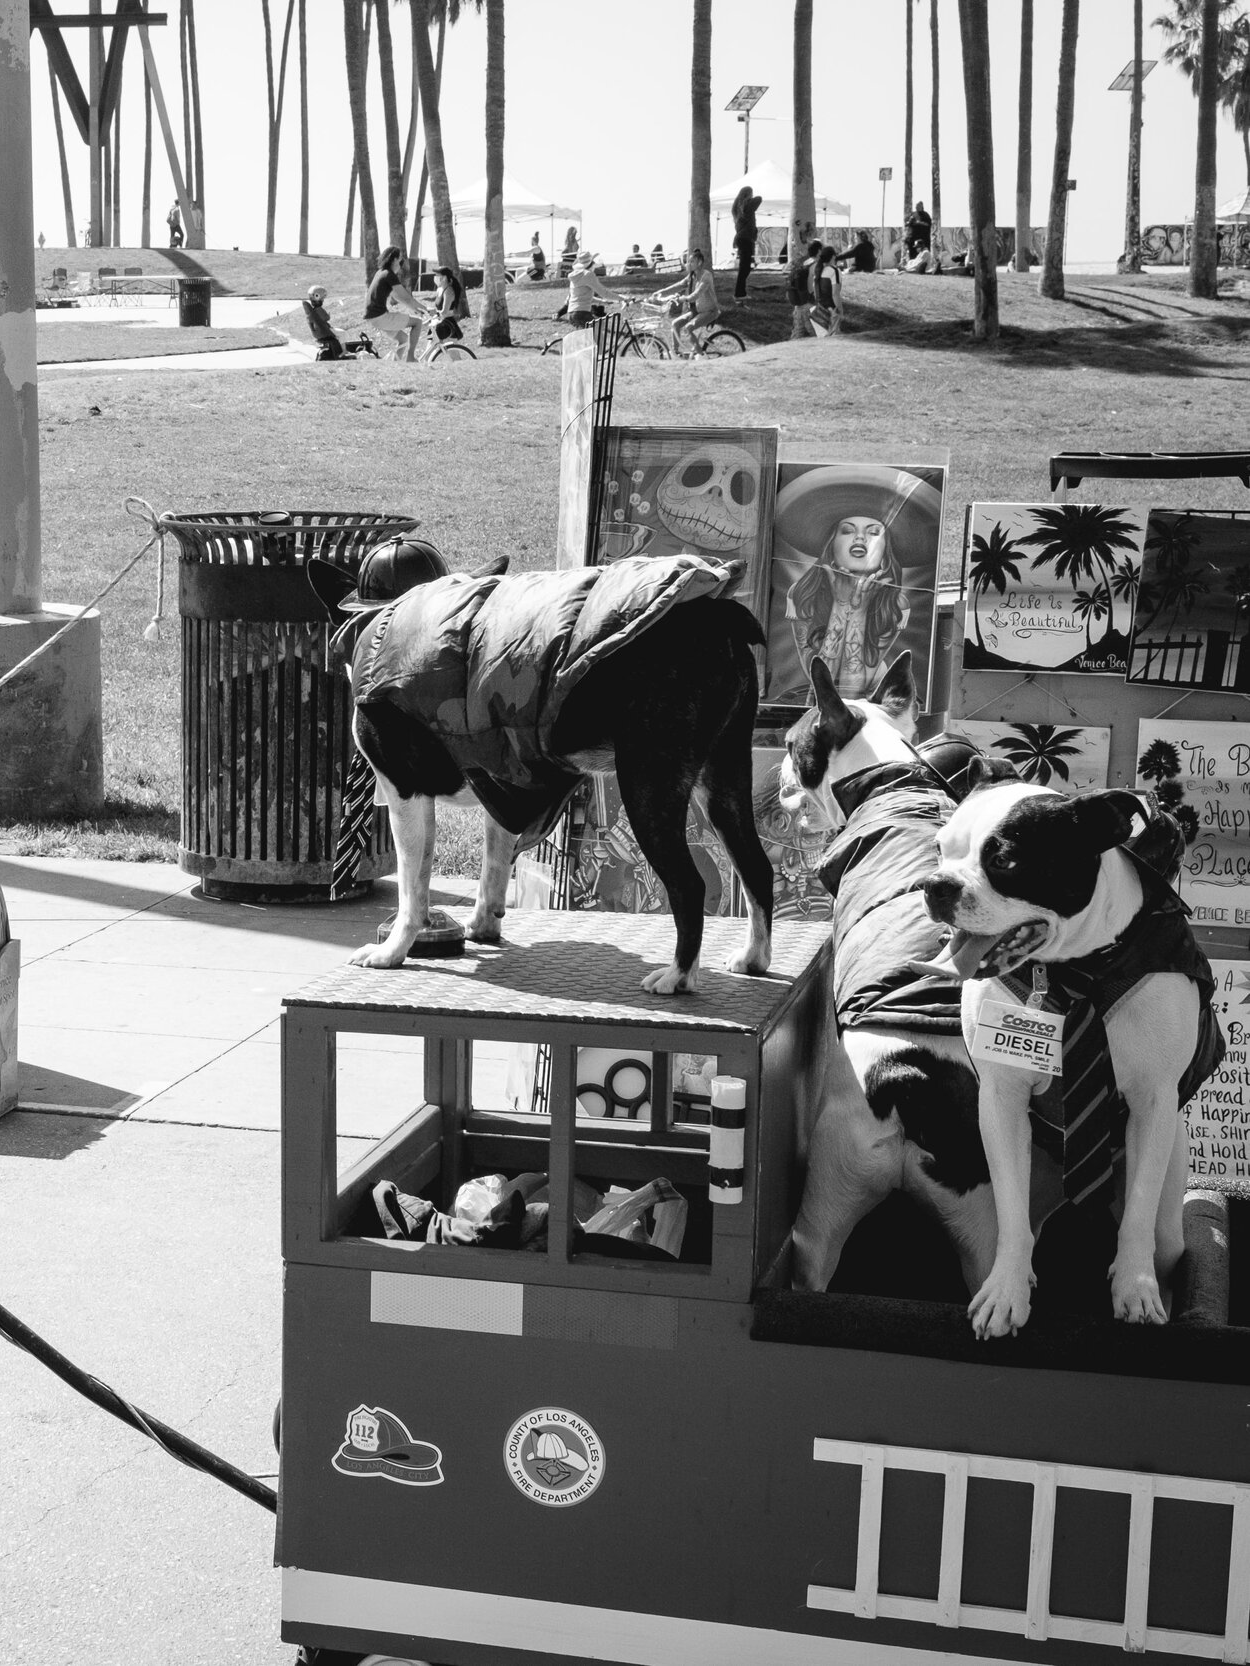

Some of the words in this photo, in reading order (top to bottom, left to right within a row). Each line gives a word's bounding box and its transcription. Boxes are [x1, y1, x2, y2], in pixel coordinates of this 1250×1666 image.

[1000, 591, 1041, 610] Life
[1009, 611, 1083, 632] Beautiful
[1075, 655, 1106, 670] Venice
[1181, 740, 1216, 780] The
[1204, 799, 1250, 837] Hap
[994, 1032, 1054, 1057] DIESEL
[1211, 1142, 1248, 1161] Hold
[355, 1423, 375, 1440] 112
[509, 1421, 530, 1459] COUNTY
[529, 1413, 544, 1425] OF
[546, 1412, 568, 1424] LOS
[568, 1418, 600, 1463] ANGELES
[346, 1460, 363, 1471] LOS
[366, 1461, 405, 1477] ANGELES
[407, 1471, 430, 1480] CITY
[513, 1469, 533, 1493] FIRE
[533, 1472, 597, 1504] DEPARTMENT
